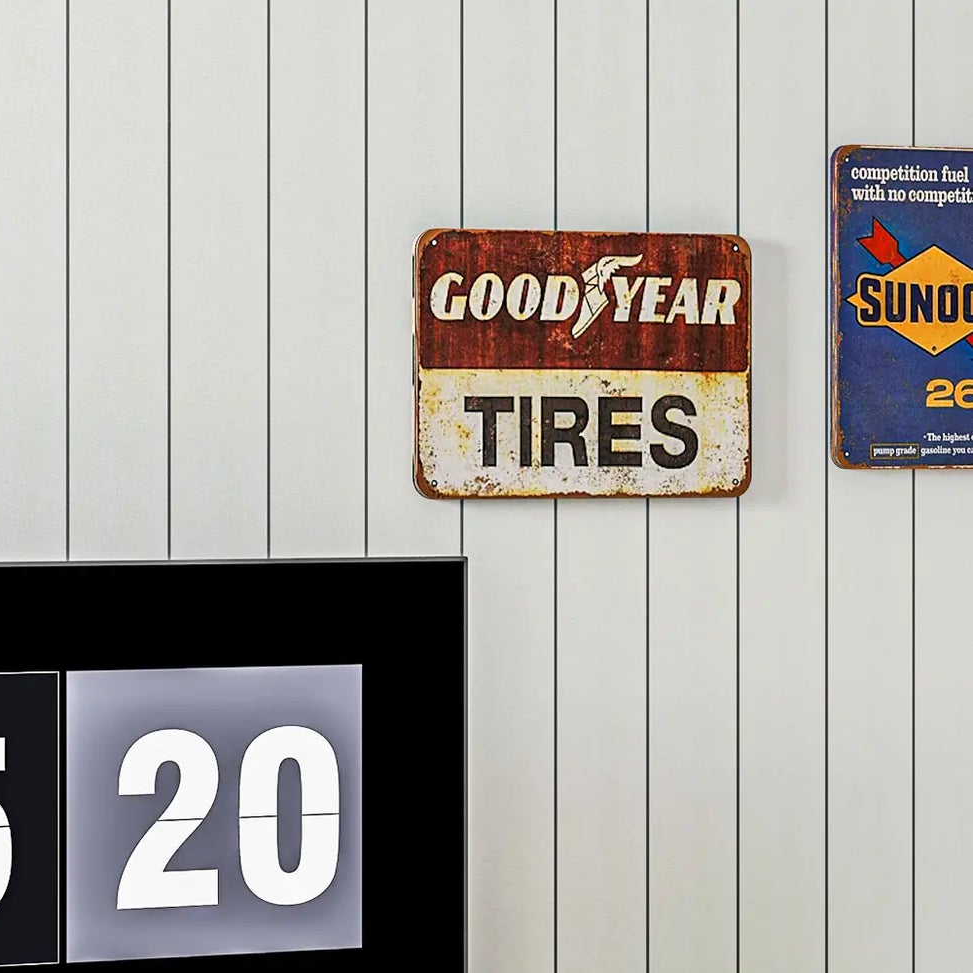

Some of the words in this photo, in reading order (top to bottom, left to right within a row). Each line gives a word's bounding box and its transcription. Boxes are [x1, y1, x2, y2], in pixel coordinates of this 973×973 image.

[851, 165, 939, 184] competition
[941, 165, 970, 183] fuel
[851, 184, 886, 202] with
[888, 189, 907, 202] no
[908, 187, 973, 207] competit
[464, 395, 699, 469] TIRES
[927, 432, 941, 442] The
[873, 448, 894, 457] pump
[895, 446, 917, 457] grade
[920, 446, 952, 457] gasoline
[952, 447, 966, 456] you
[117, 725, 340, 911] 20
